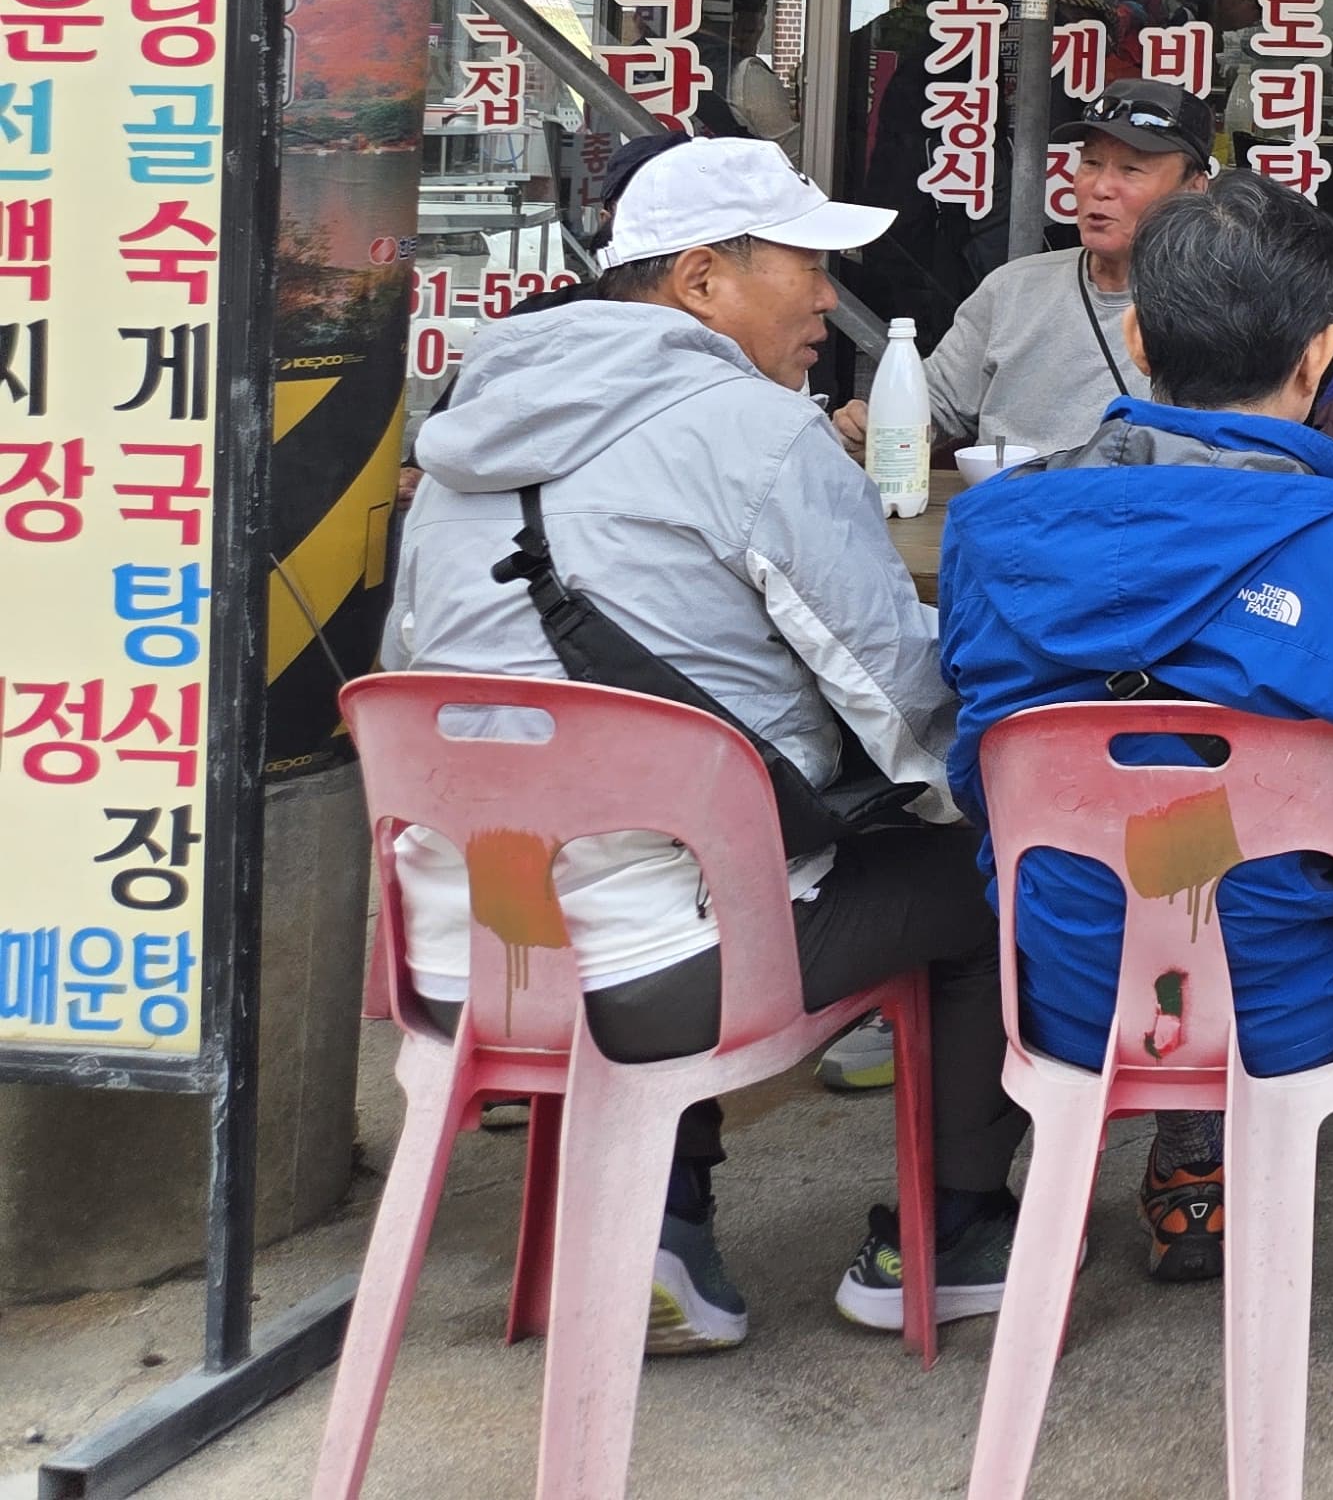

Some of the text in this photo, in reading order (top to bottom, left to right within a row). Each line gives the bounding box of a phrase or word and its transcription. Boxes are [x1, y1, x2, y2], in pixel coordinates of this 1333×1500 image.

[112, 562, 210, 667] 탕
[1236, 588, 1281, 610] NORTH
[1244, 601, 1280, 620] FACE
[1261, 582, 1287, 600] THE
[0, 677, 201, 787] 정식
[94, 805, 201, 911] 장
[0, 927, 196, 1036] 매운탕
